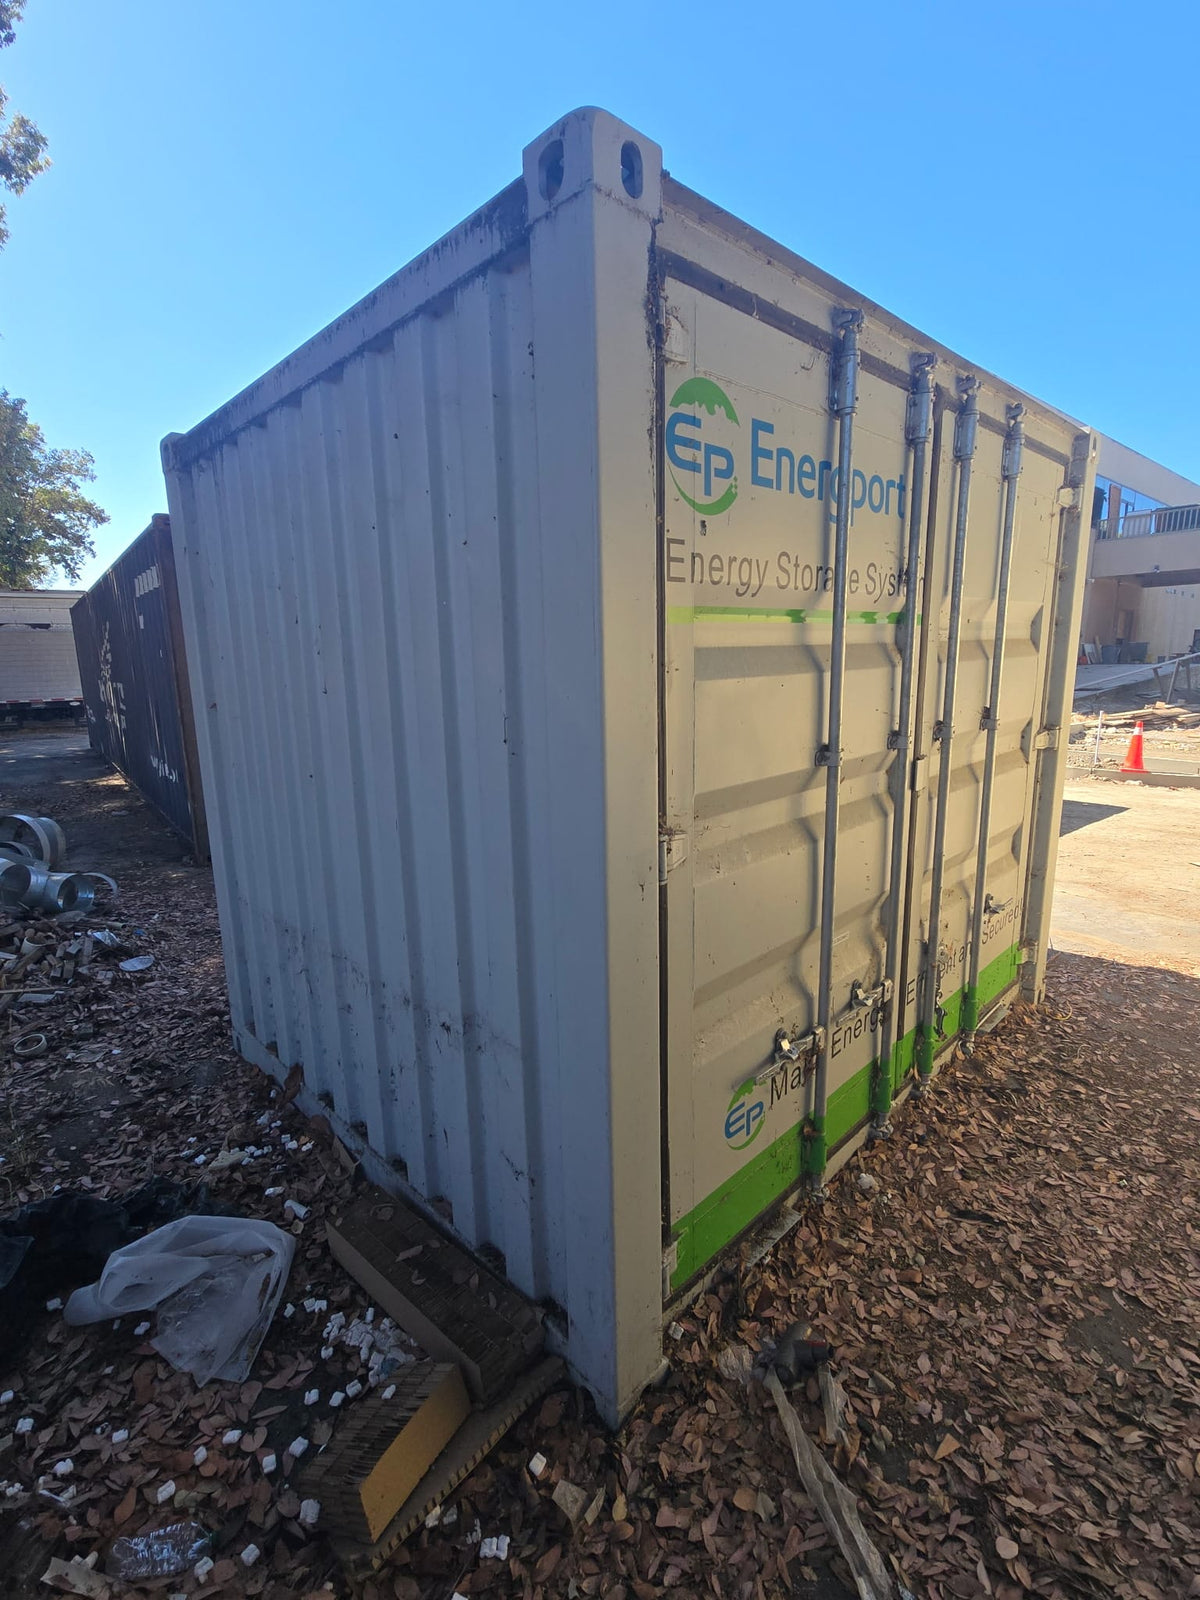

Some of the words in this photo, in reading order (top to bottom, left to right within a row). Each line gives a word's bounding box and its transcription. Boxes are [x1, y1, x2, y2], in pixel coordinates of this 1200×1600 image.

[665, 411, 735, 497] EP
[666, 537, 769, 598] Energy
[776, 551, 860, 595] Storae
[866, 561, 925, 604] Syst
[831, 1006, 885, 1059] Energ
[724, 1100, 764, 1139] EP
